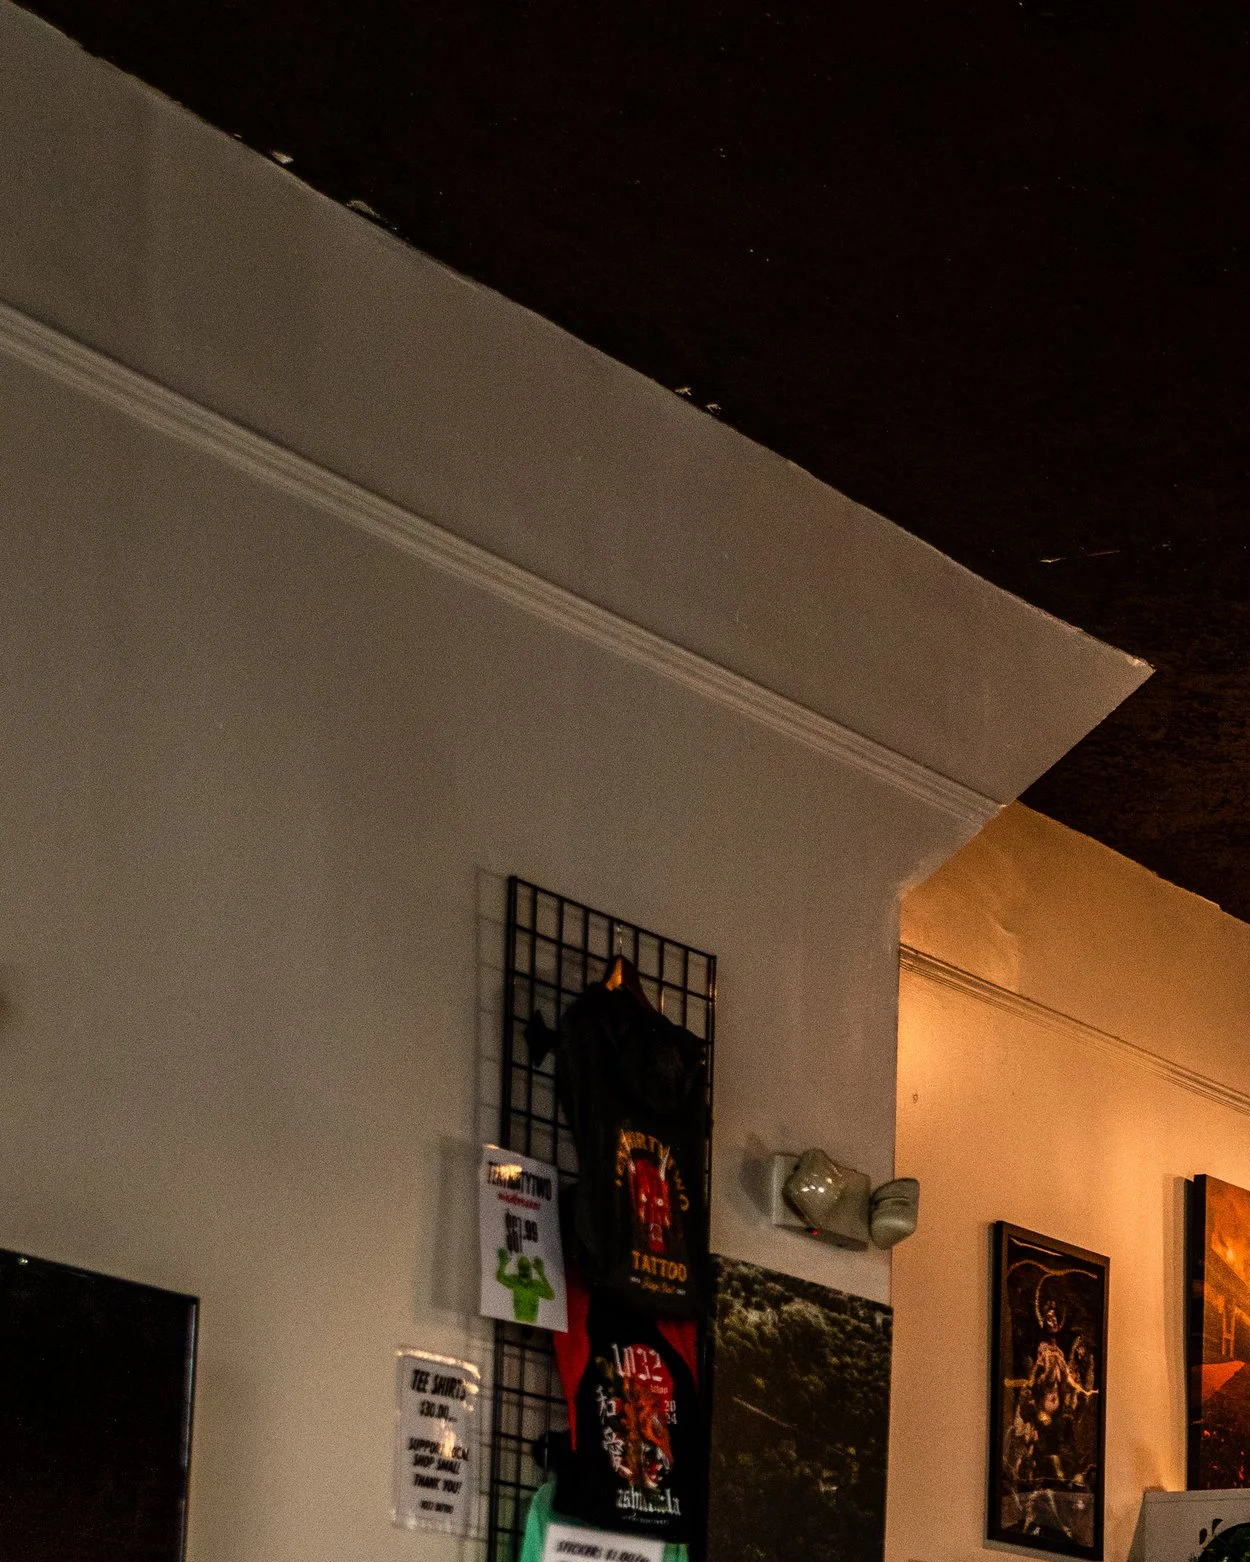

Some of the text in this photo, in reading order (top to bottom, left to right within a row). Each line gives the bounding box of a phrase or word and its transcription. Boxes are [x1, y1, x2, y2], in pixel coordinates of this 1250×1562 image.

[631, 1250, 688, 1282] TATTOO
[411, 1368, 467, 1401] TEE SHIRTS
